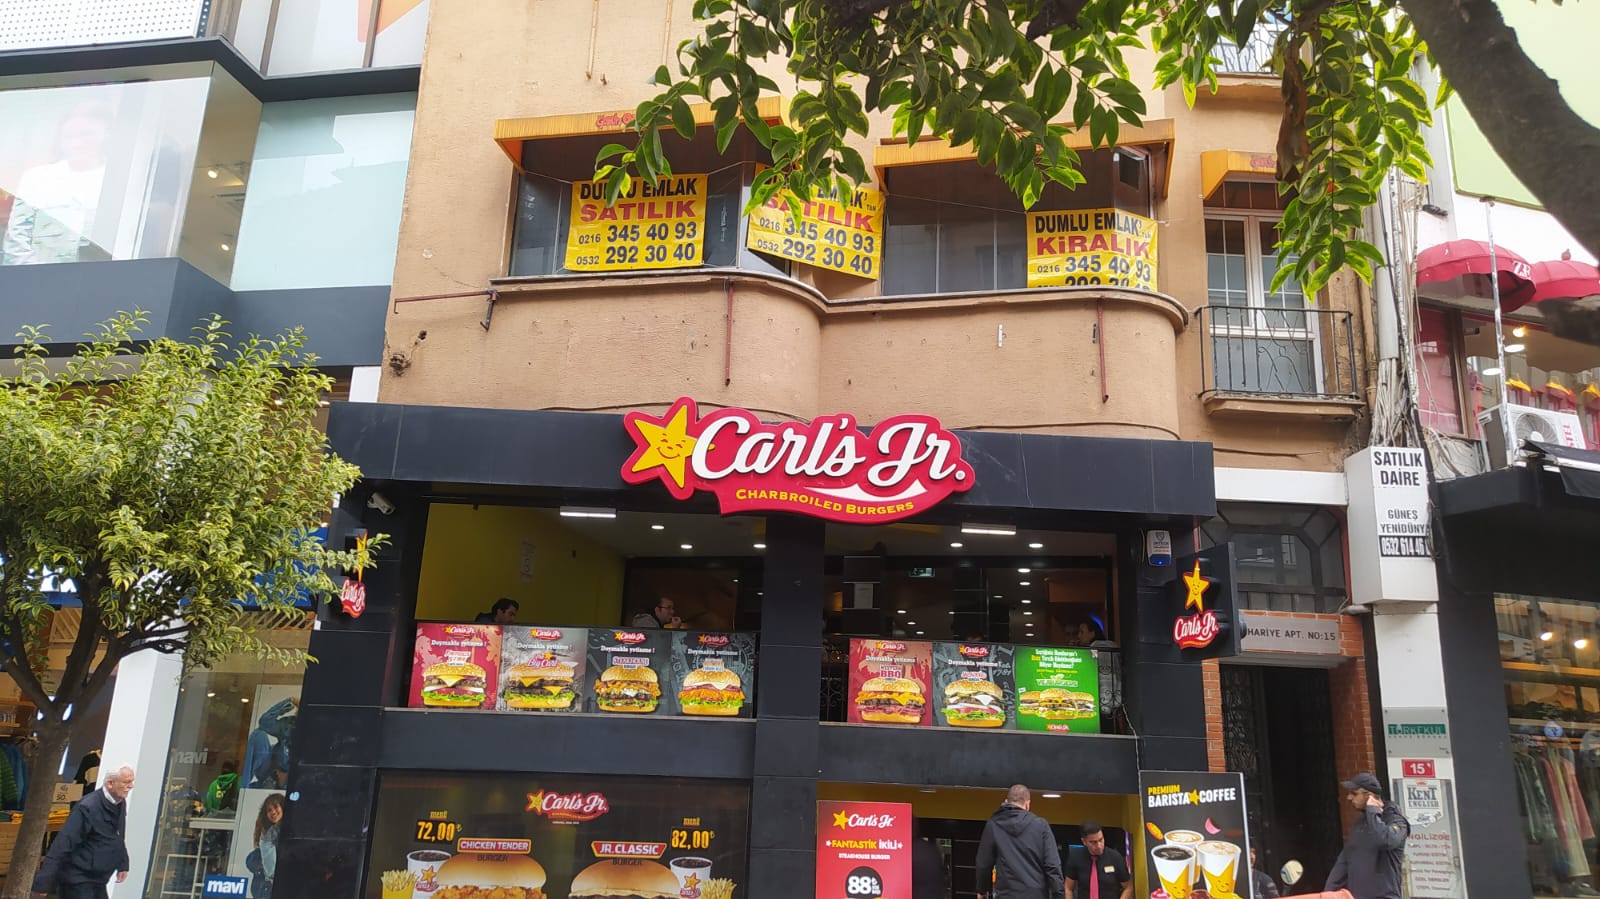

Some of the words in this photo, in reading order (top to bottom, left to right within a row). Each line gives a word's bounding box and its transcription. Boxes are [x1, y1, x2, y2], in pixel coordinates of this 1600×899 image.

[642, 178, 697, 198] EMLAK
[580, 200, 697, 222] SATILIK
[578, 234, 601, 244] 0216
[607, 225, 640, 242] 345
[646, 223, 669, 240] 40
[675, 221, 697, 239] 93
[1035, 213, 1089, 233] DUMLU
[760, 217, 781, 232] 0216
[824, 228, 847, 246] 40
[852, 233, 874, 253] 93
[576, 256, 600, 265] 0532
[605, 246, 639, 264] 292
[644, 245, 667, 262] 30
[673, 243, 695, 260] 40
[757, 239, 780, 253] 0532
[782, 238, 817, 262] 292
[822, 247, 845, 268] 30
[850, 254, 873, 275] 40
[1037, 265, 1060, 273] 0216
[1065, 255, 1102, 272] 345
[1108, 255, 1131, 274] 40
[1135, 259, 1151, 282] 93
[691, 416, 866, 480] Carl's
[867, 422, 966, 487] Jr.
[1374, 451, 1423, 467] SATILIK
[1380, 468, 1420, 486] DAİRE
[736, 489, 843, 512] CHARBROILED
[846, 501, 915, 515] BURGERS
[1388, 508, 1418, 521] GÜNEŞ
[1175, 613, 1202, 640] Carl's
[1248, 626, 1280, 638] HARİYE
[1285, 629, 1305, 638] APT.
[1410, 763, 1425, 775] 15
[1148, 784, 1180, 795] PREMIUM
[1148, 792, 1190, 808] BARISTA
[1199, 788, 1236, 803] COFFEE
[1408, 787, 1437, 800] KENT
[542, 793, 583, 811] Carl's
[848, 813, 879, 828] Carl's
[460, 840, 496, 849] CHICKEN
[497, 842, 529, 850] TENDER
[831, 839, 877, 849] FANTASTİK
[207, 879, 246, 895] mavi
